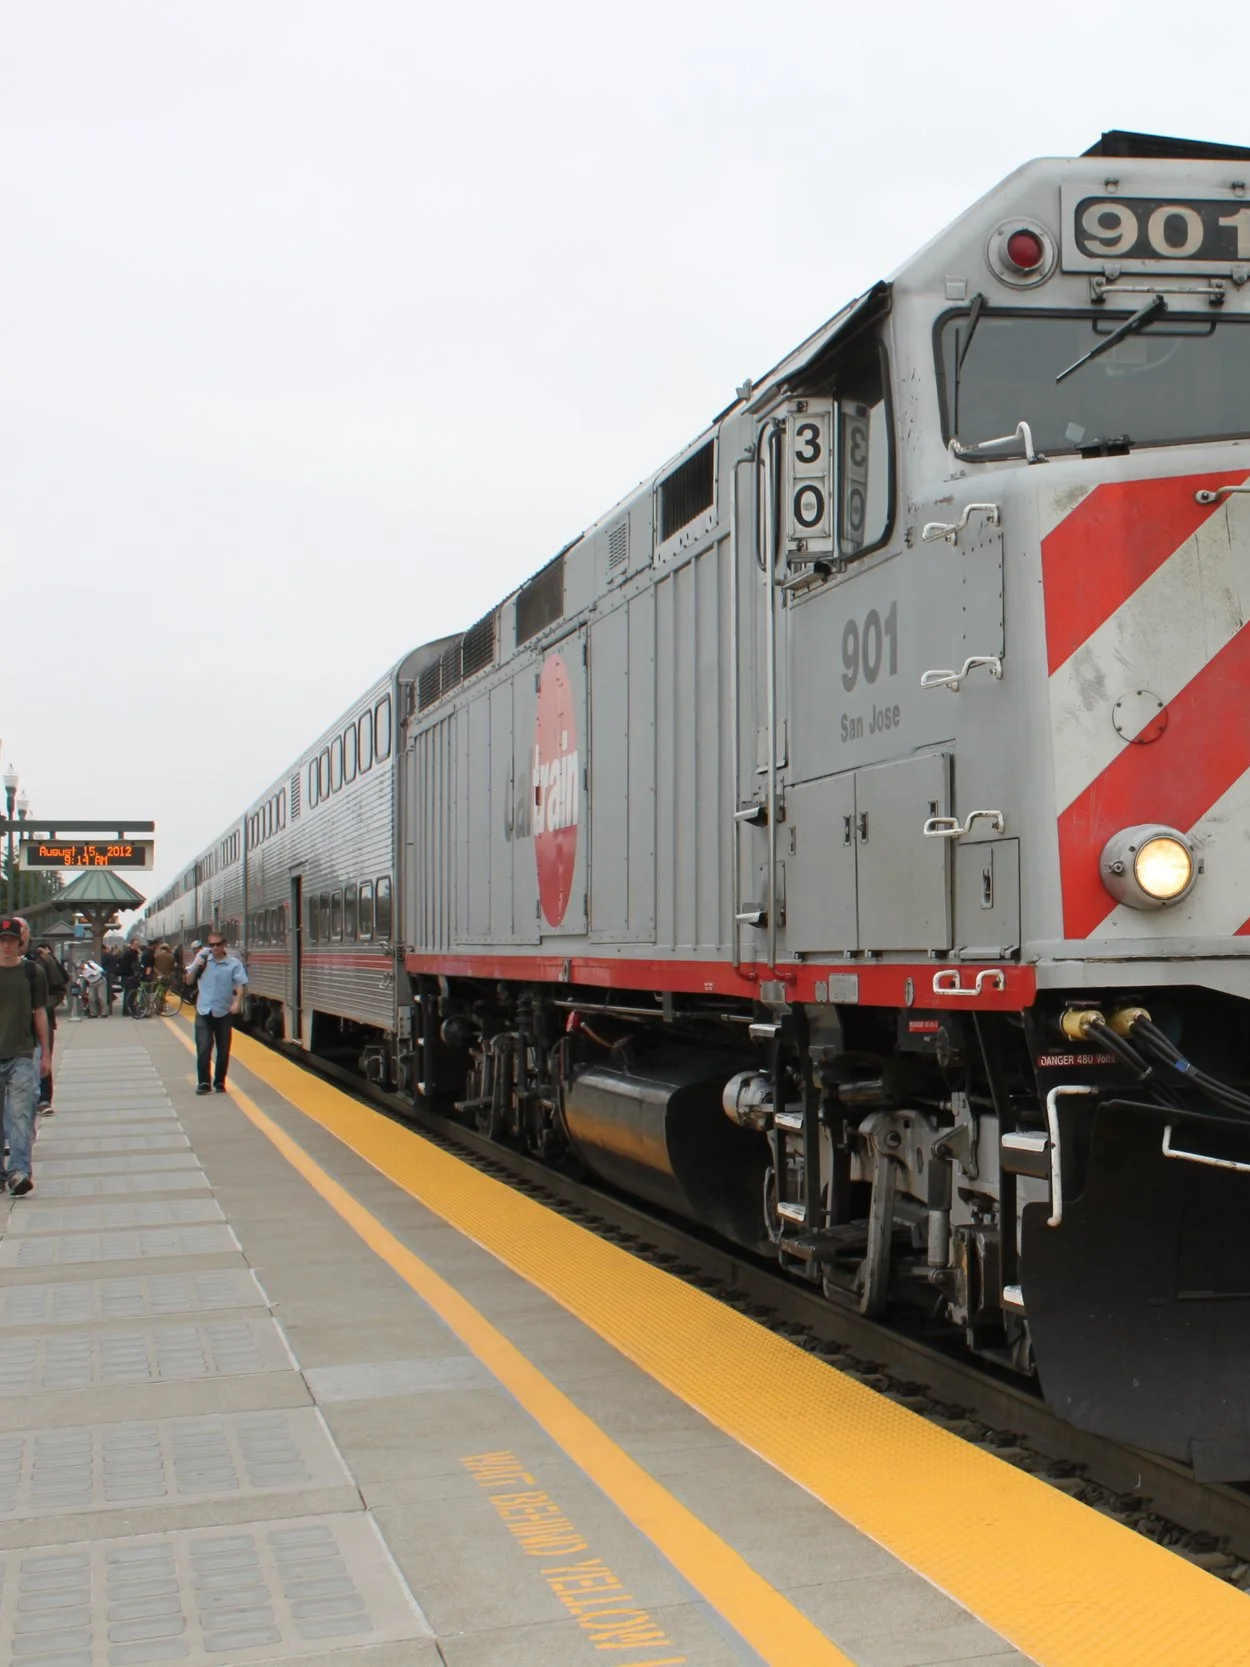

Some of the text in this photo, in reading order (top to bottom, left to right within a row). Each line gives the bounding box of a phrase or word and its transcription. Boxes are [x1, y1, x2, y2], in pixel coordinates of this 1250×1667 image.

[841, 600, 898, 692] 901
[840, 703, 901, 743] San Jose
[39, 846, 76, 858] August
[106, 846, 132, 857] 2012
[95, 856, 108, 866] AM
[1041, 1055, 1074, 1066] DANGER
[1077, 1054, 1093, 1064] 480
[460, 1451, 537, 1487] WAIT
[489, 1491, 588, 1556] BEHIND
[541, 1558, 672, 1650] YELLOW
